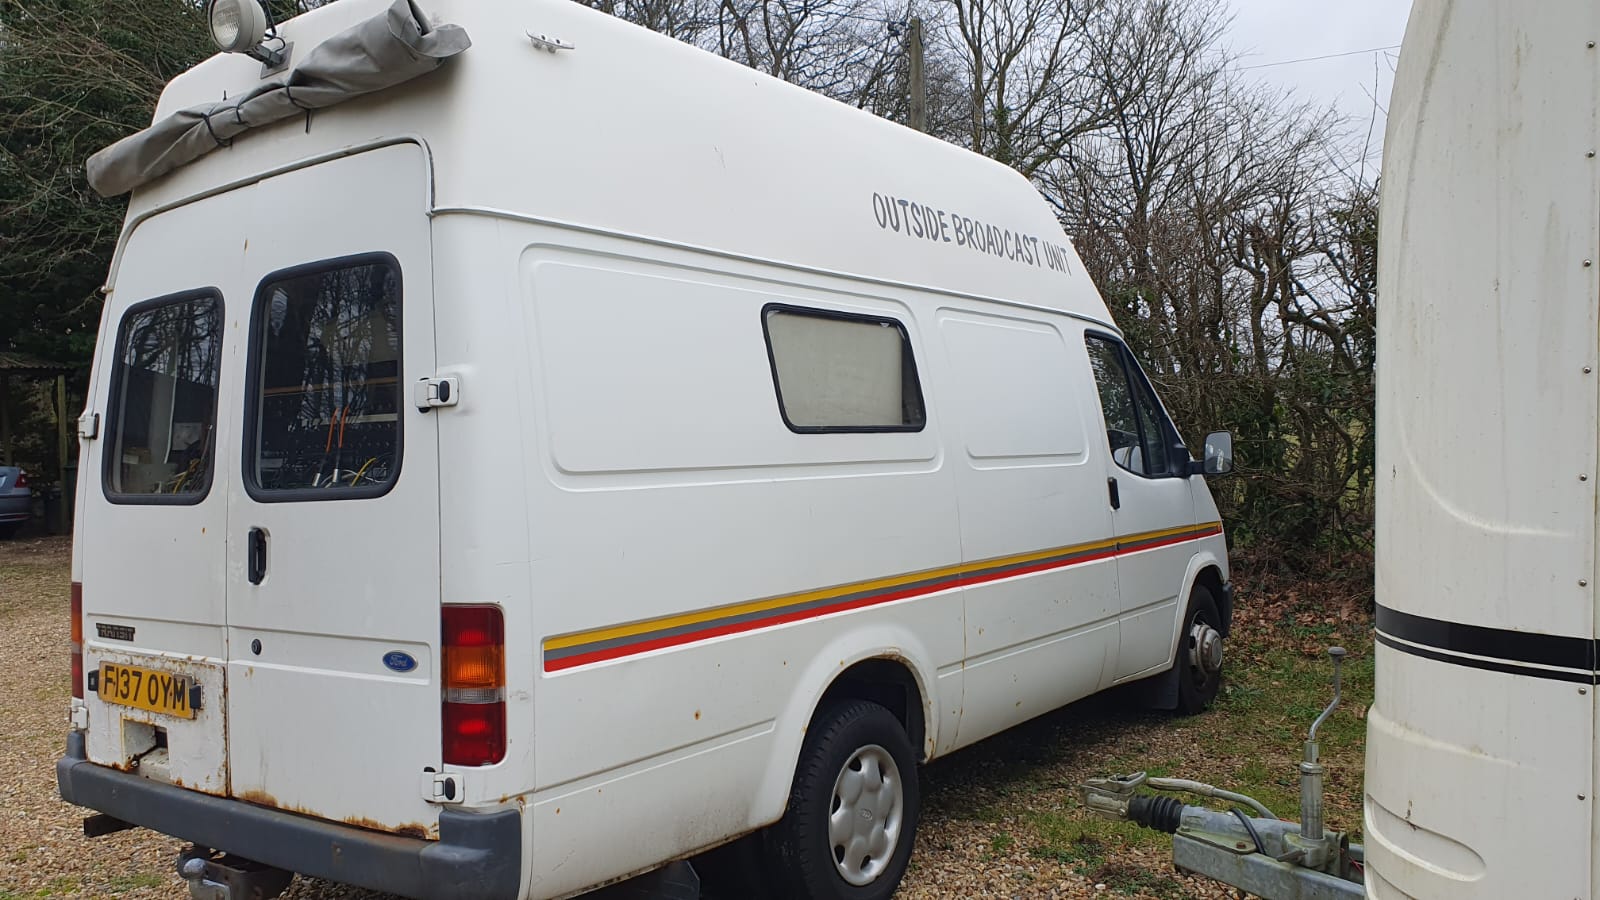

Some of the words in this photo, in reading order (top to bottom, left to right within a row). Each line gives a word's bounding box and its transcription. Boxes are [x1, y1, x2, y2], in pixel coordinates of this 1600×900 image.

[872, 191, 951, 242] OUTSIDE
[951, 213, 1041, 268] BROADCAST
[1042, 240, 1072, 277] UNIT
[103, 665, 142, 702] F137
